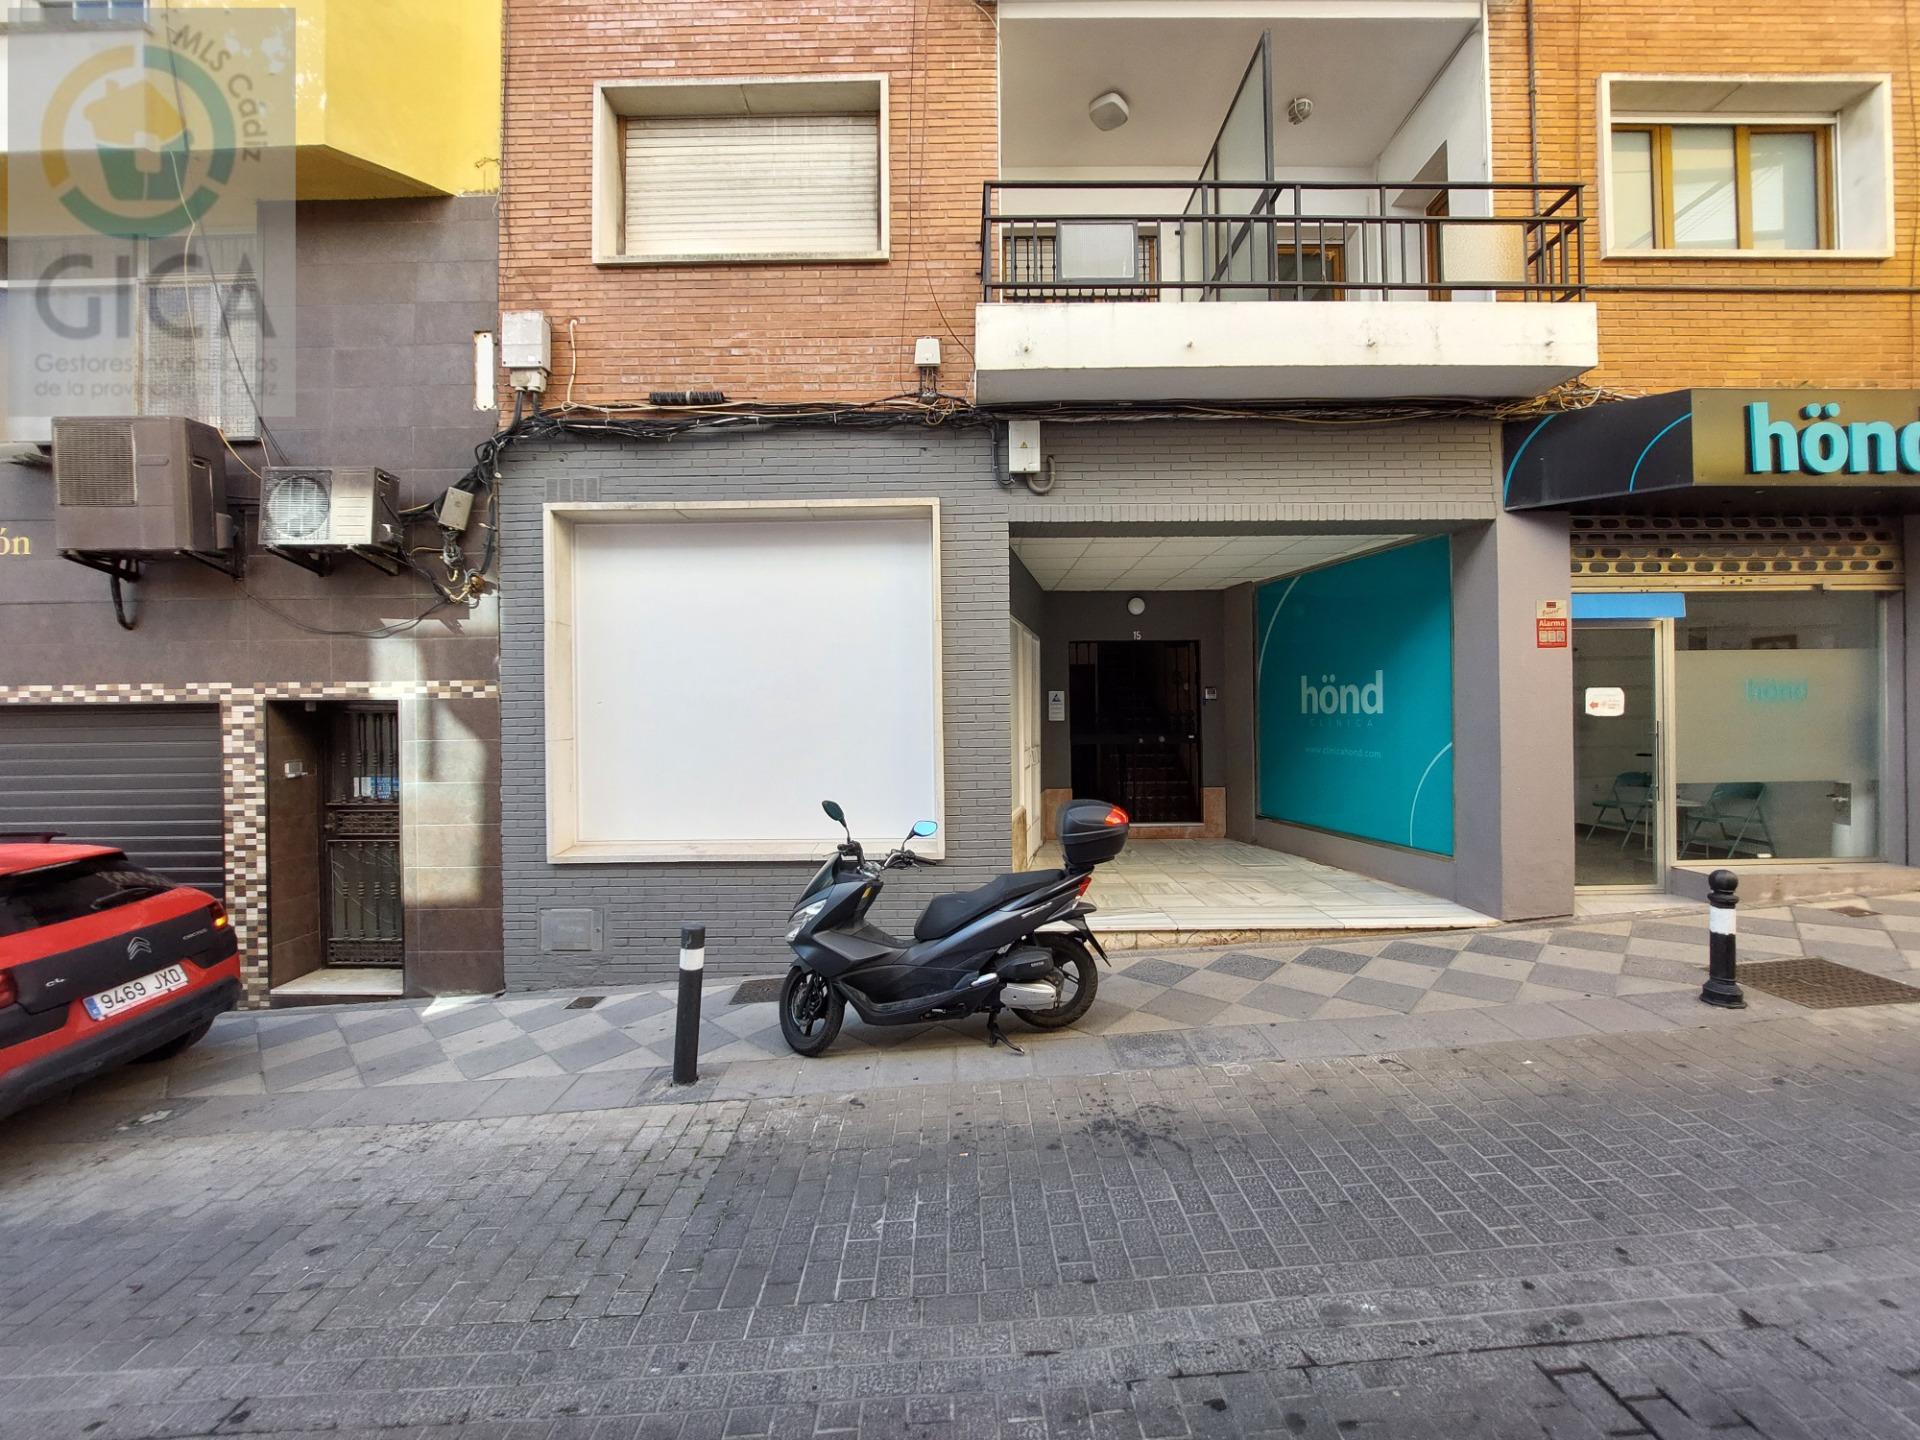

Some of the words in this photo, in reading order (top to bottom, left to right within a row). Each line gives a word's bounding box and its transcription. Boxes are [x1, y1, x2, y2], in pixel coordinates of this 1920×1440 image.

[1133, 631, 1142, 640] 15
[1301, 670, 1383, 714] hönd
[100, 981, 147, 1009] 9469
[154, 968, 181, 990] JXD
